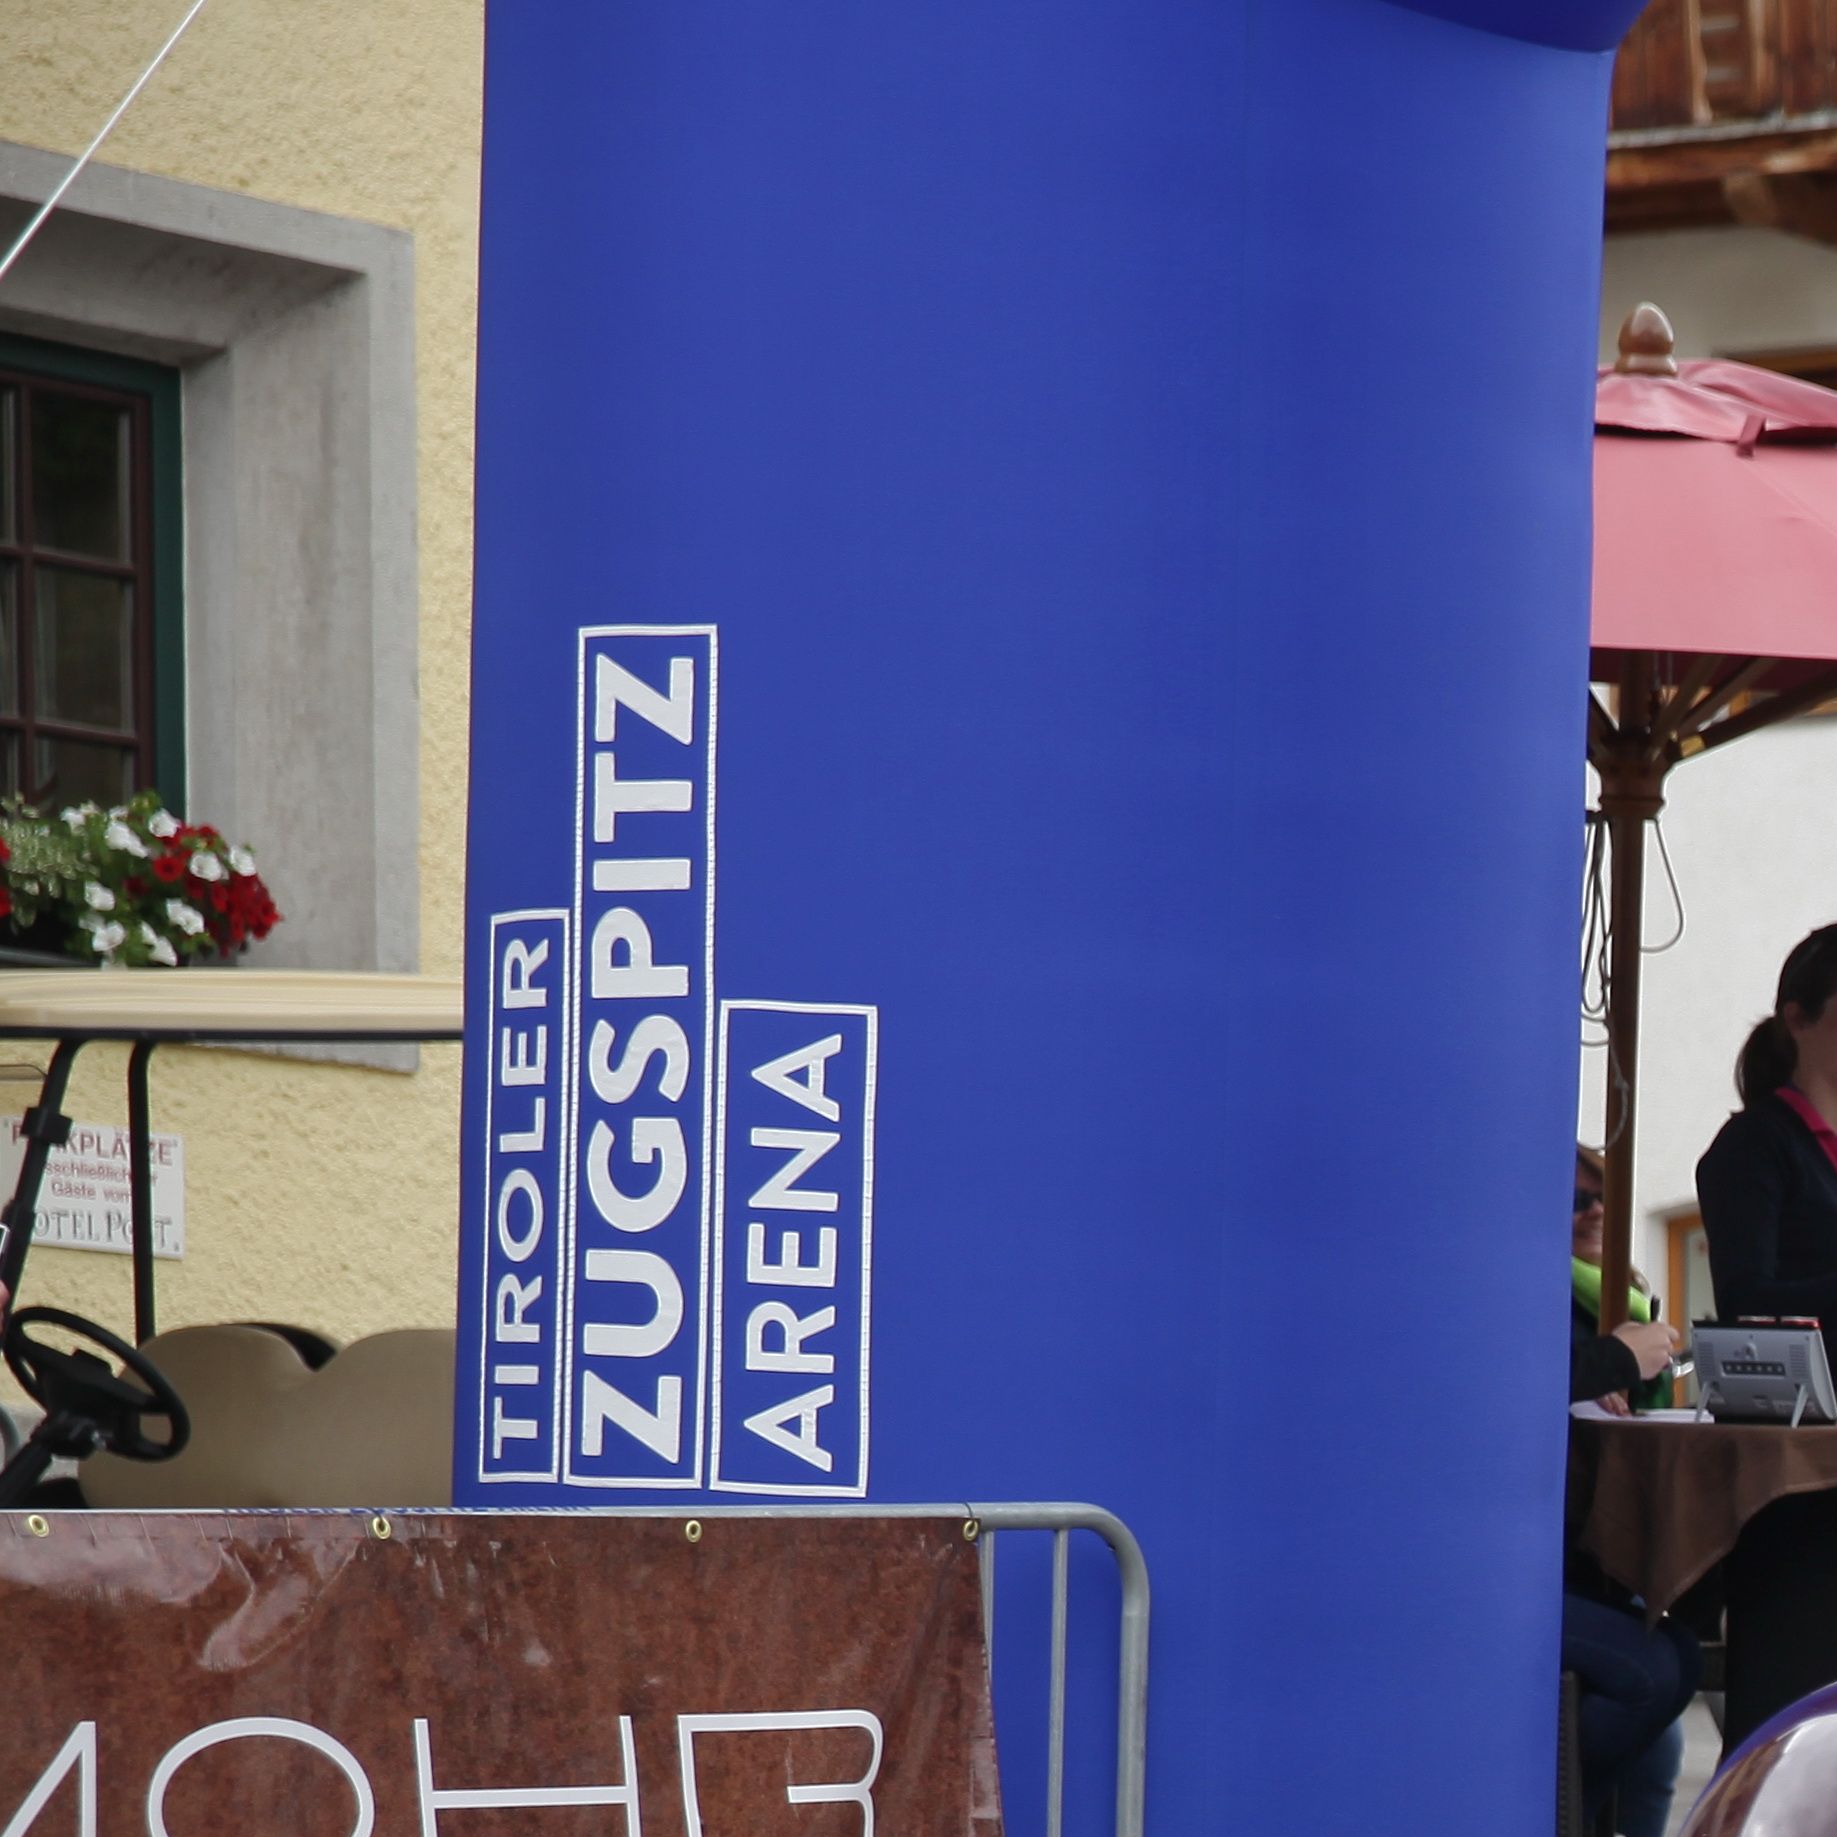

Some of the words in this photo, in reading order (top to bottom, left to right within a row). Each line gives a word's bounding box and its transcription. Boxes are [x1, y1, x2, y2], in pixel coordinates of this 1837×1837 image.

[34, 1208, 100, 1242] OTEL
[106, 1210, 173, 1249] POT
[493, 936, 550, 1460] TIROLER
[582, 652, 696, 1465] ZUGSPITZ
[743, 1033, 843, 1473] ARENA
